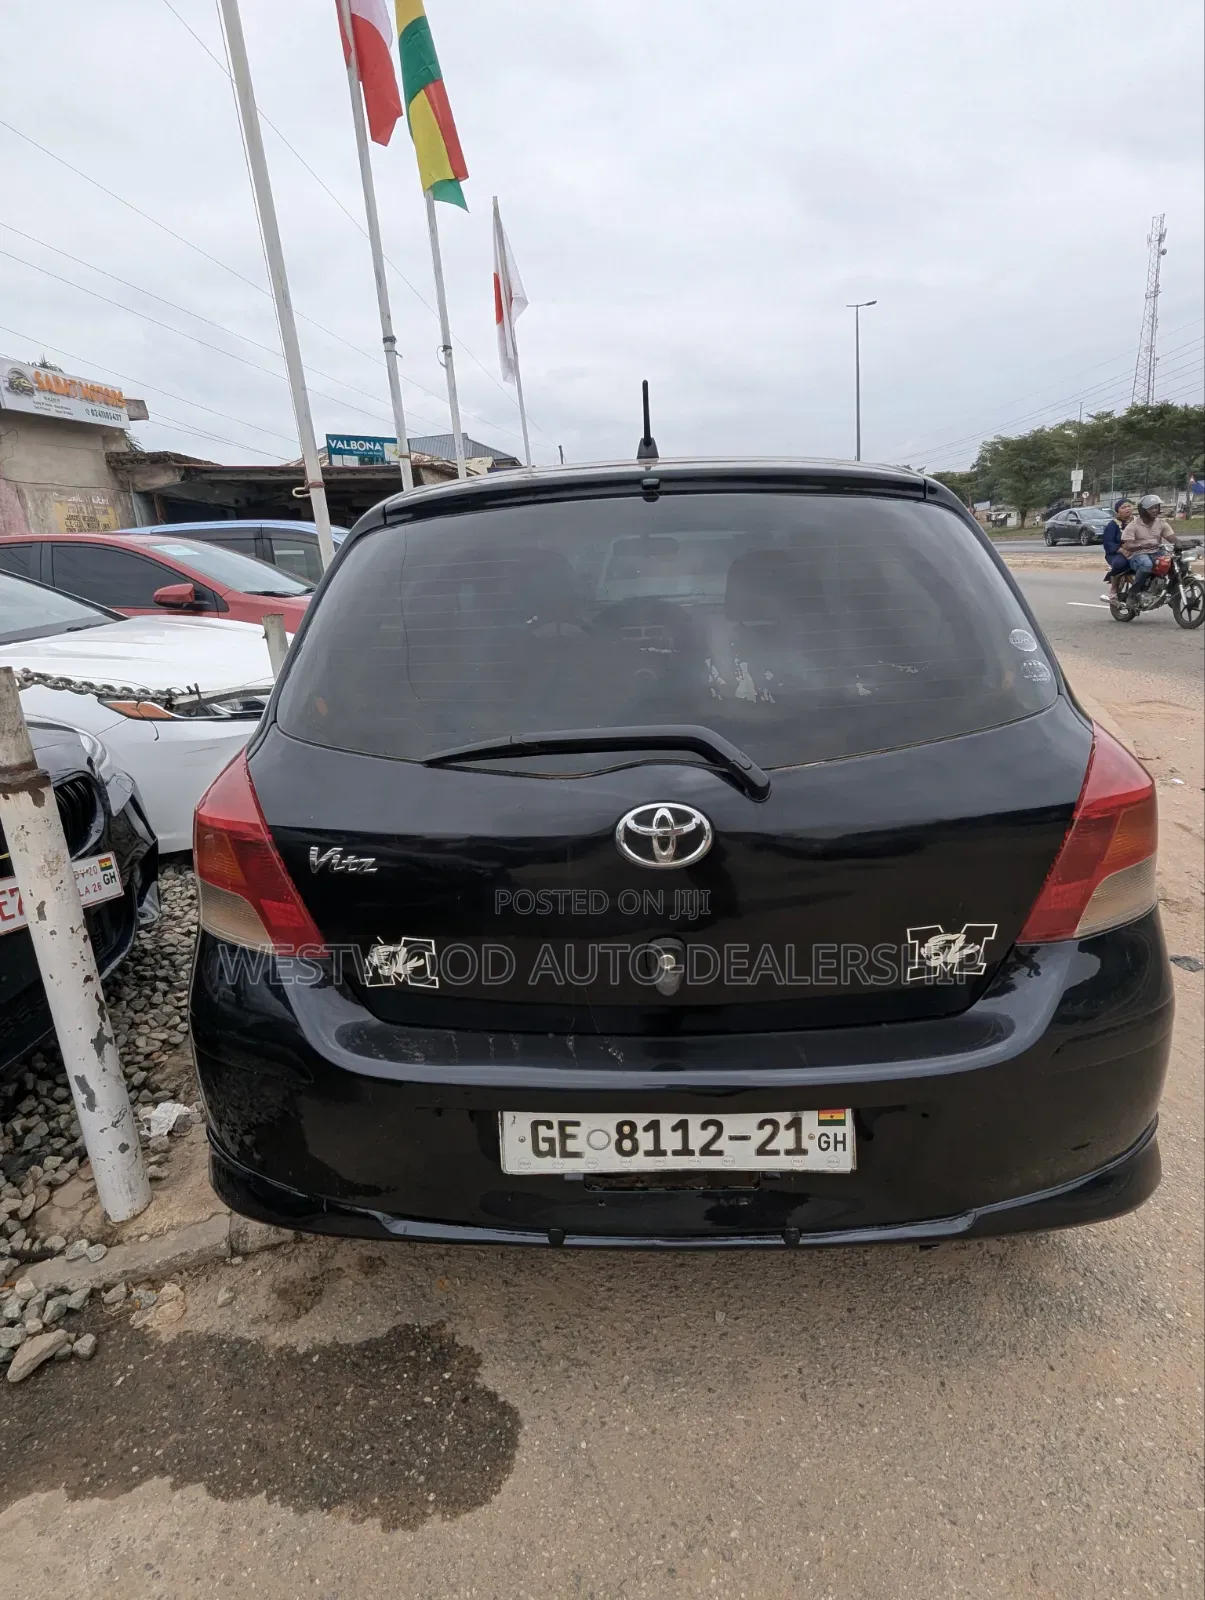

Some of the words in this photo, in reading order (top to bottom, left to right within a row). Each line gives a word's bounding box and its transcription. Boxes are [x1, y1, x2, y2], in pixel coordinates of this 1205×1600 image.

[328, 439, 383, 451] VALBONA
[309, 846, 379, 874] Vitz
[102, 871, 118, 886] GH
[530, 1119, 585, 1159] GE
[614, 1116, 809, 1158] 8112-21
[817, 1132, 848, 1153] GH
